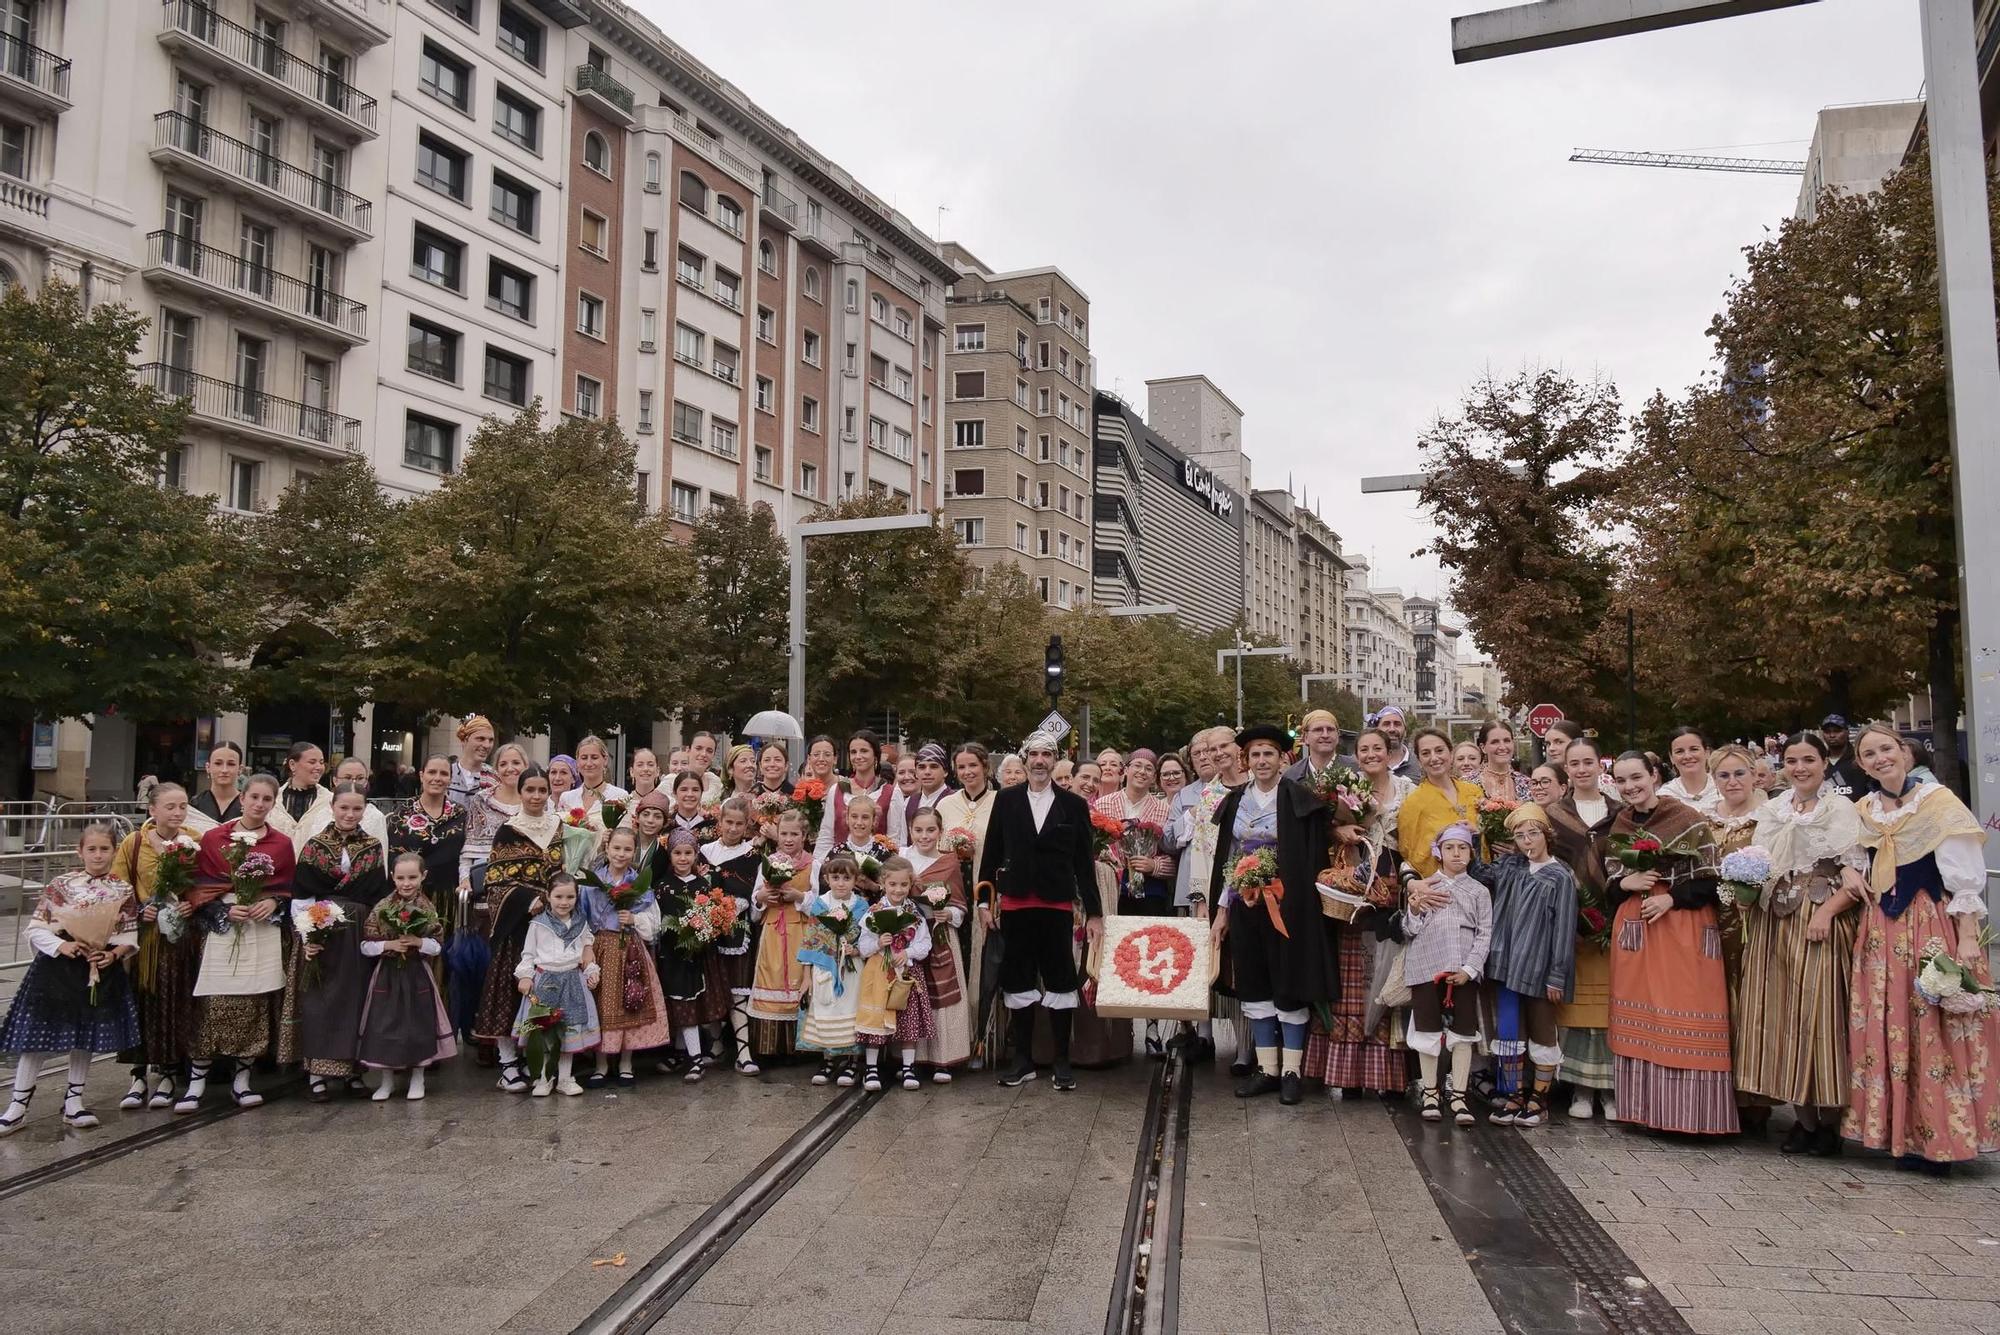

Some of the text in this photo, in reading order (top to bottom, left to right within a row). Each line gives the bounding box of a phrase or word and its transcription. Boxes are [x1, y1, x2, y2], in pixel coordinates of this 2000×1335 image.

[1185, 460, 1194, 488] El
[1194, 467, 1211, 499] Corte
[1532, 716, 1560, 725] STOP
[1047, 721, 1062, 732] 30
